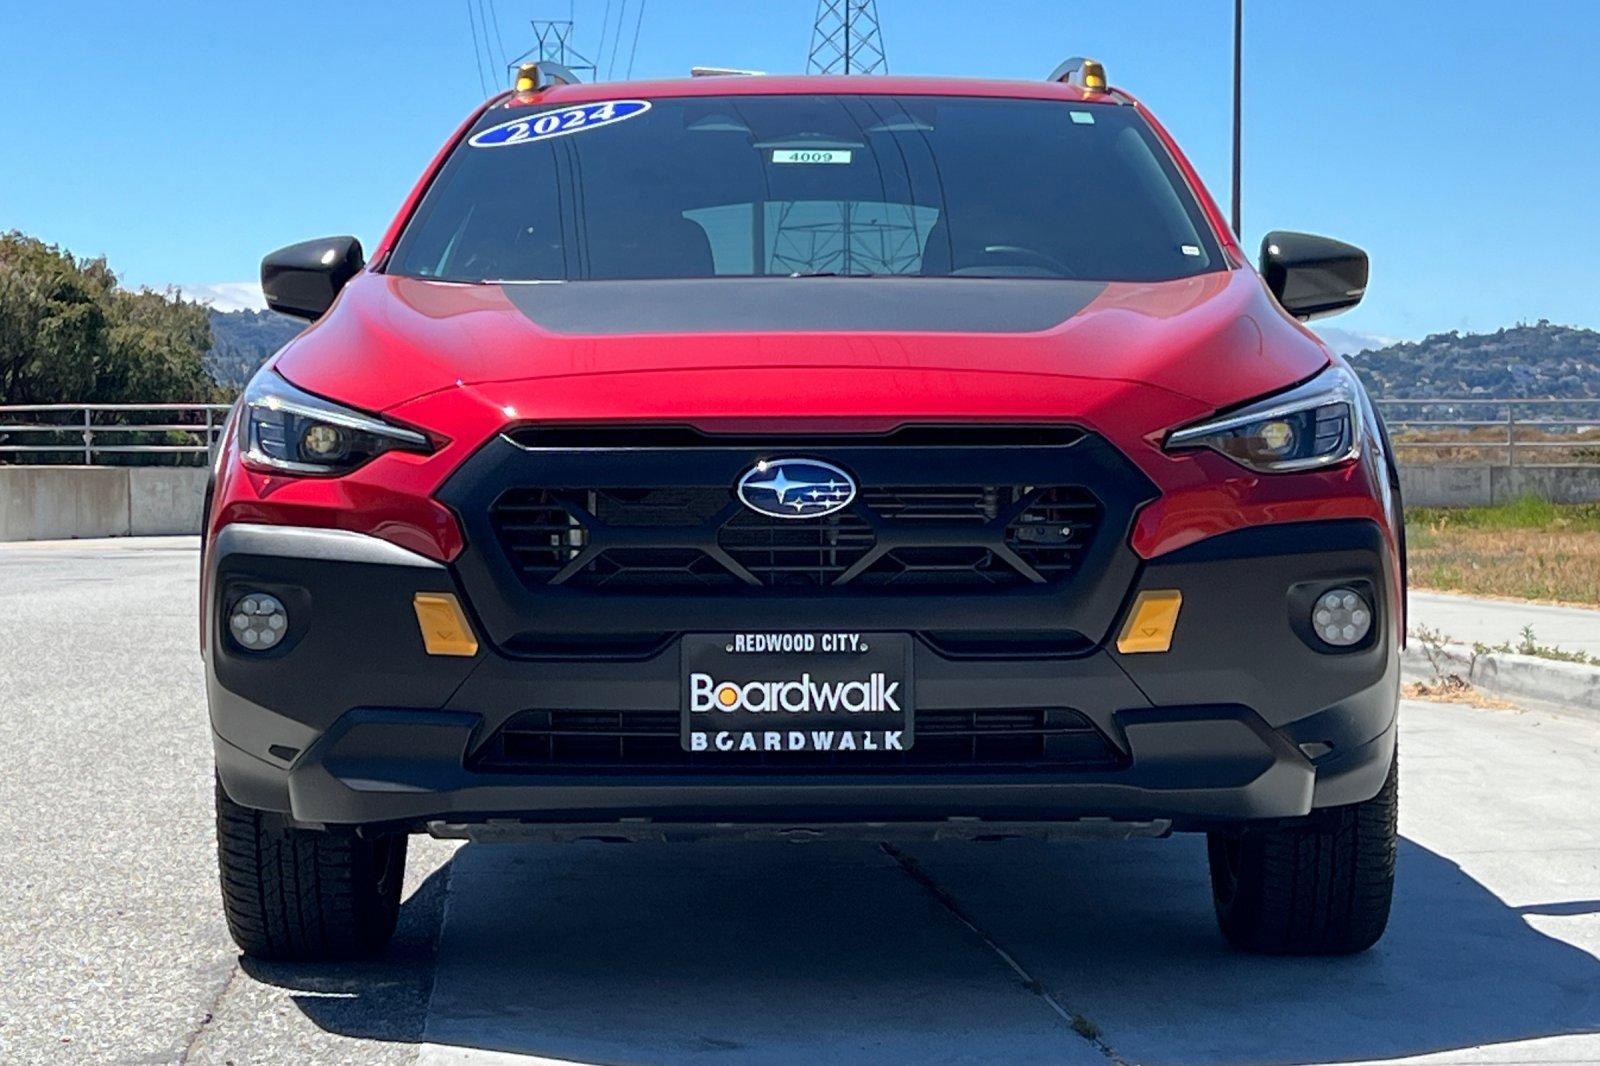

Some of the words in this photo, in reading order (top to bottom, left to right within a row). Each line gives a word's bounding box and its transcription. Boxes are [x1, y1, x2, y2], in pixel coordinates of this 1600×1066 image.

[505, 103, 616, 143] 2024
[789, 152, 833, 162] 4009
[735, 634, 815, 652] REDWOOD
[821, 634, 860, 652] CITY
[690, 673, 901, 712] Boardwalk
[691, 731, 903, 751] BOARDWALK
